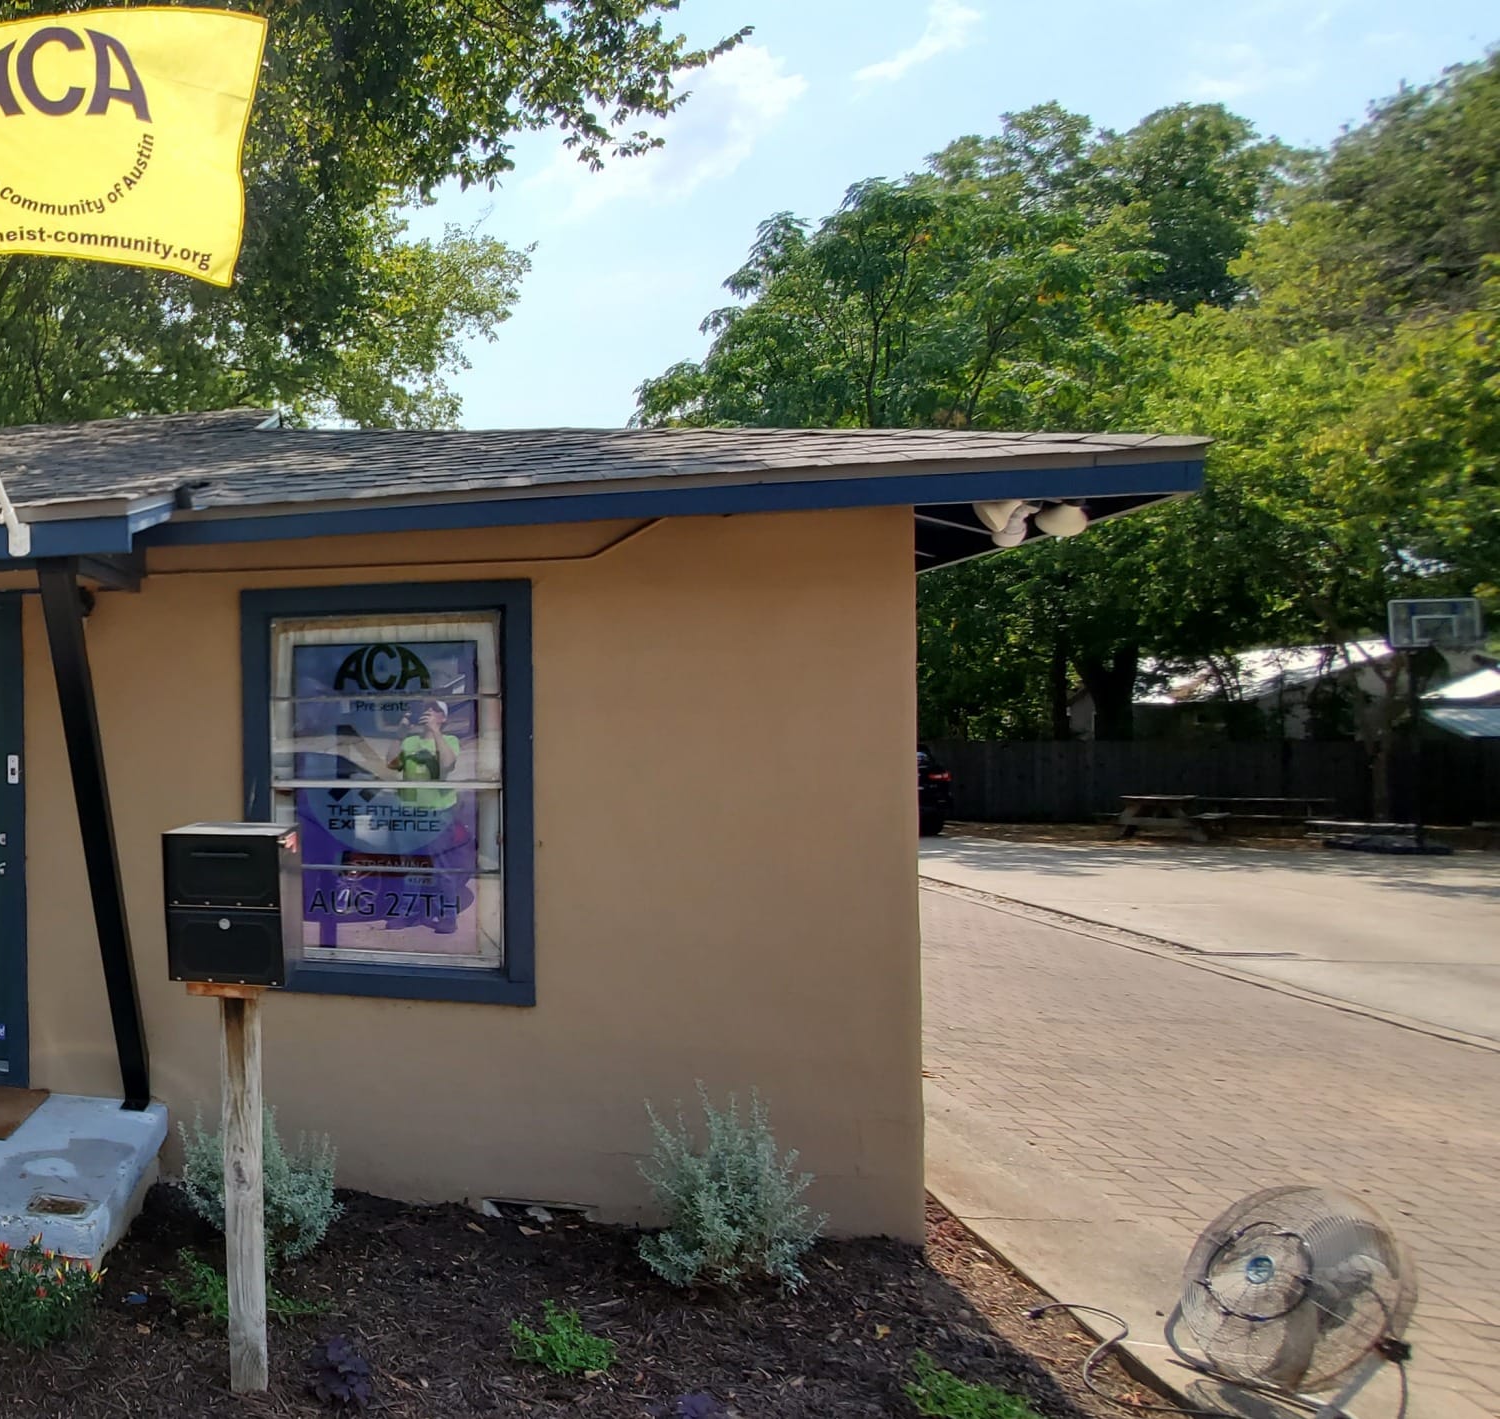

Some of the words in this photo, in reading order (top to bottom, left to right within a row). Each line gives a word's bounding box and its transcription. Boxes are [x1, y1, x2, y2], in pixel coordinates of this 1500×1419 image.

[0, 186, 105, 216] Community
[107, 182, 125, 204] of
[122, 133, 155, 191] Austin
[334, 643, 432, 690] ACA
[356, 700, 411, 711] Preents
[327, 805, 362, 816] THE
[366, 805, 439, 817] ATHEIST
[329, 819, 441, 831] EXERIENCE
[308, 890, 375, 916] AUG
[386, 893, 461, 918] 27TH
